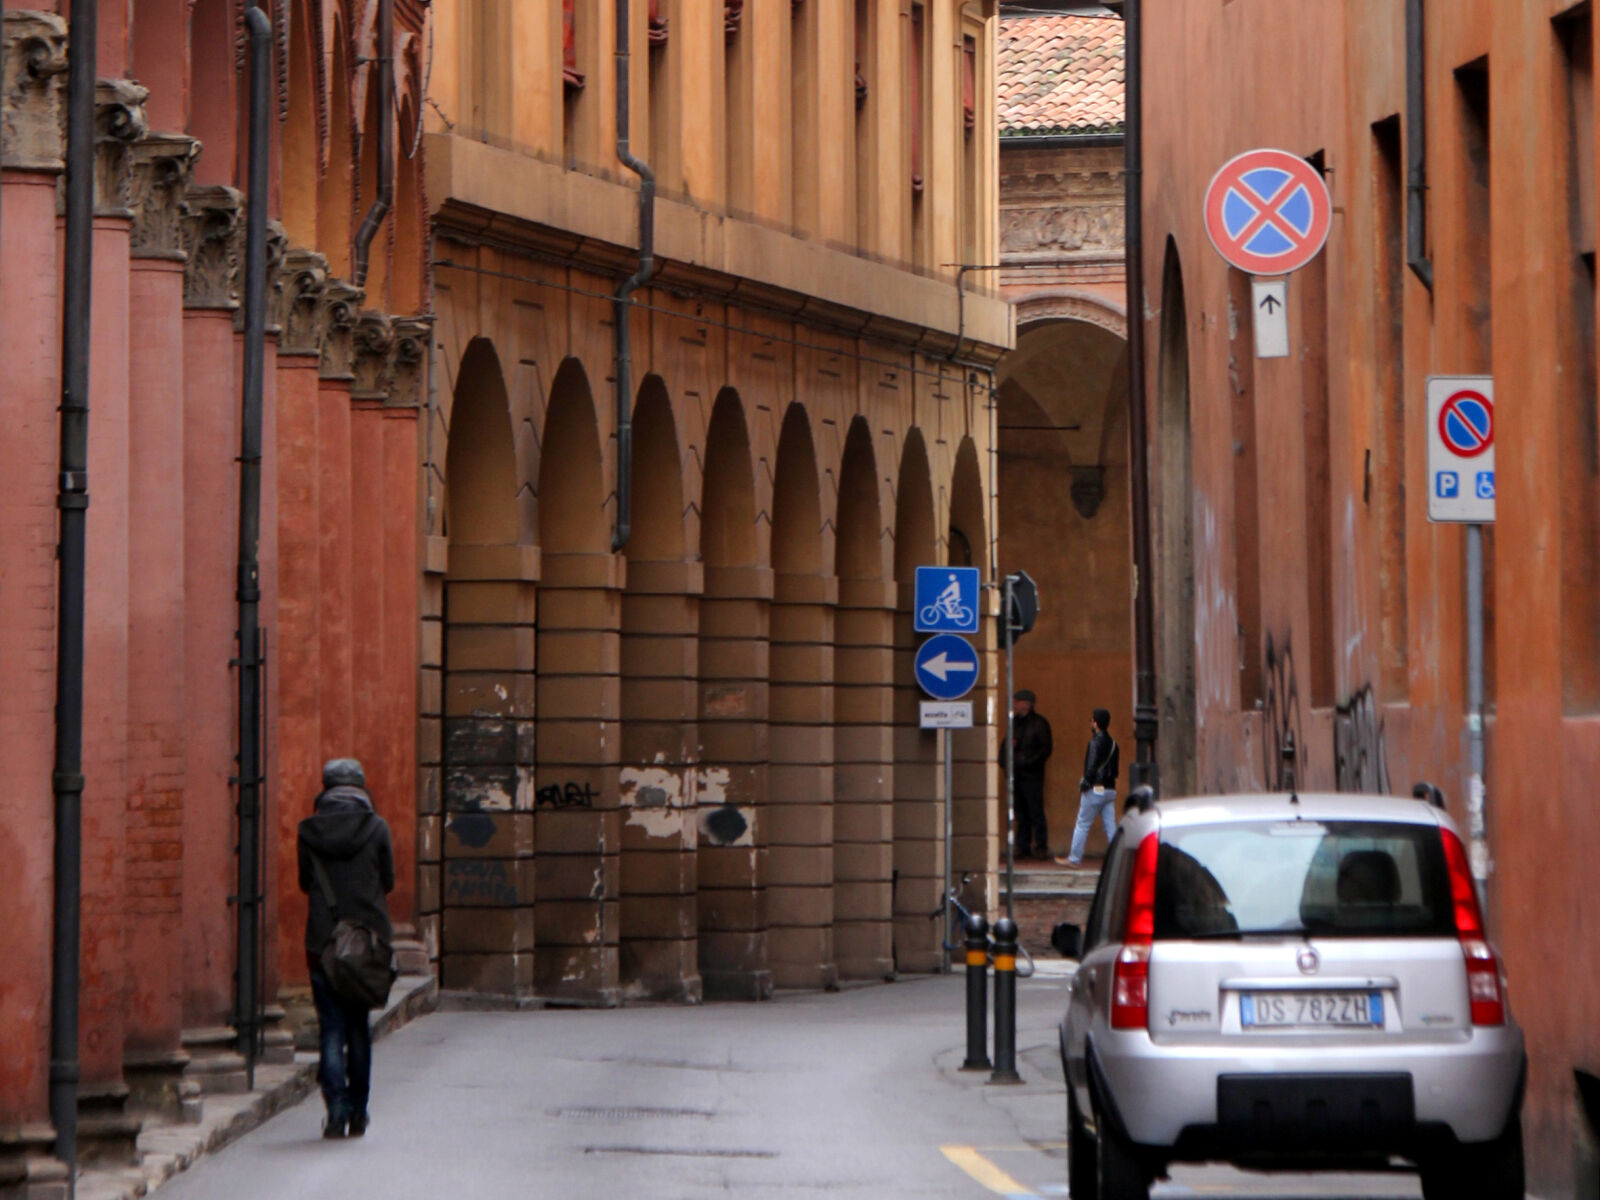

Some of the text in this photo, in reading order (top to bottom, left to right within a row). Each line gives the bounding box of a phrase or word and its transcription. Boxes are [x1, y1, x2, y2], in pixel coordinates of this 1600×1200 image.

[1440, 474, 1456, 497] P
[1257, 996, 1369, 1023] DS 782ZH
